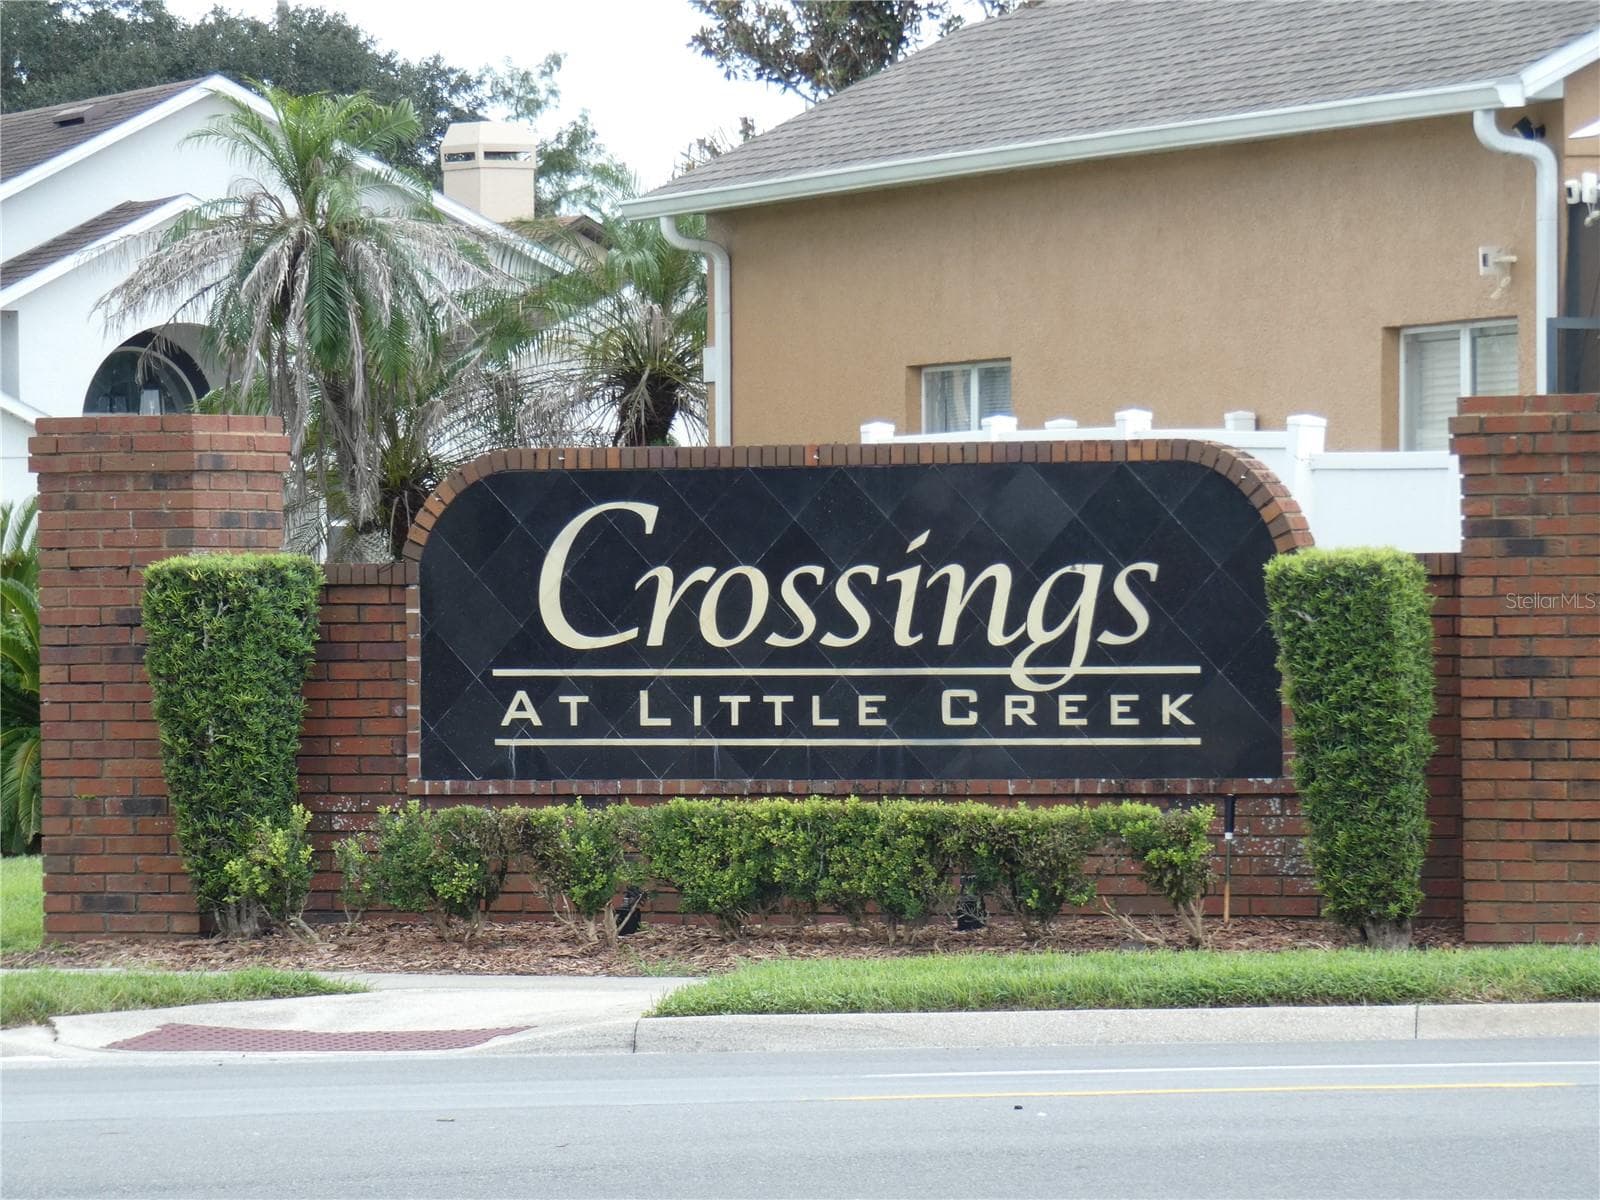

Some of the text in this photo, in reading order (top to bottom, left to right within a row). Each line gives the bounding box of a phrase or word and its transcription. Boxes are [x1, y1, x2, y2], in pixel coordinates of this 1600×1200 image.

[538, 501, 1160, 692] Crossings
[500, 688, 1196, 727] AT LITTLE CREEK
